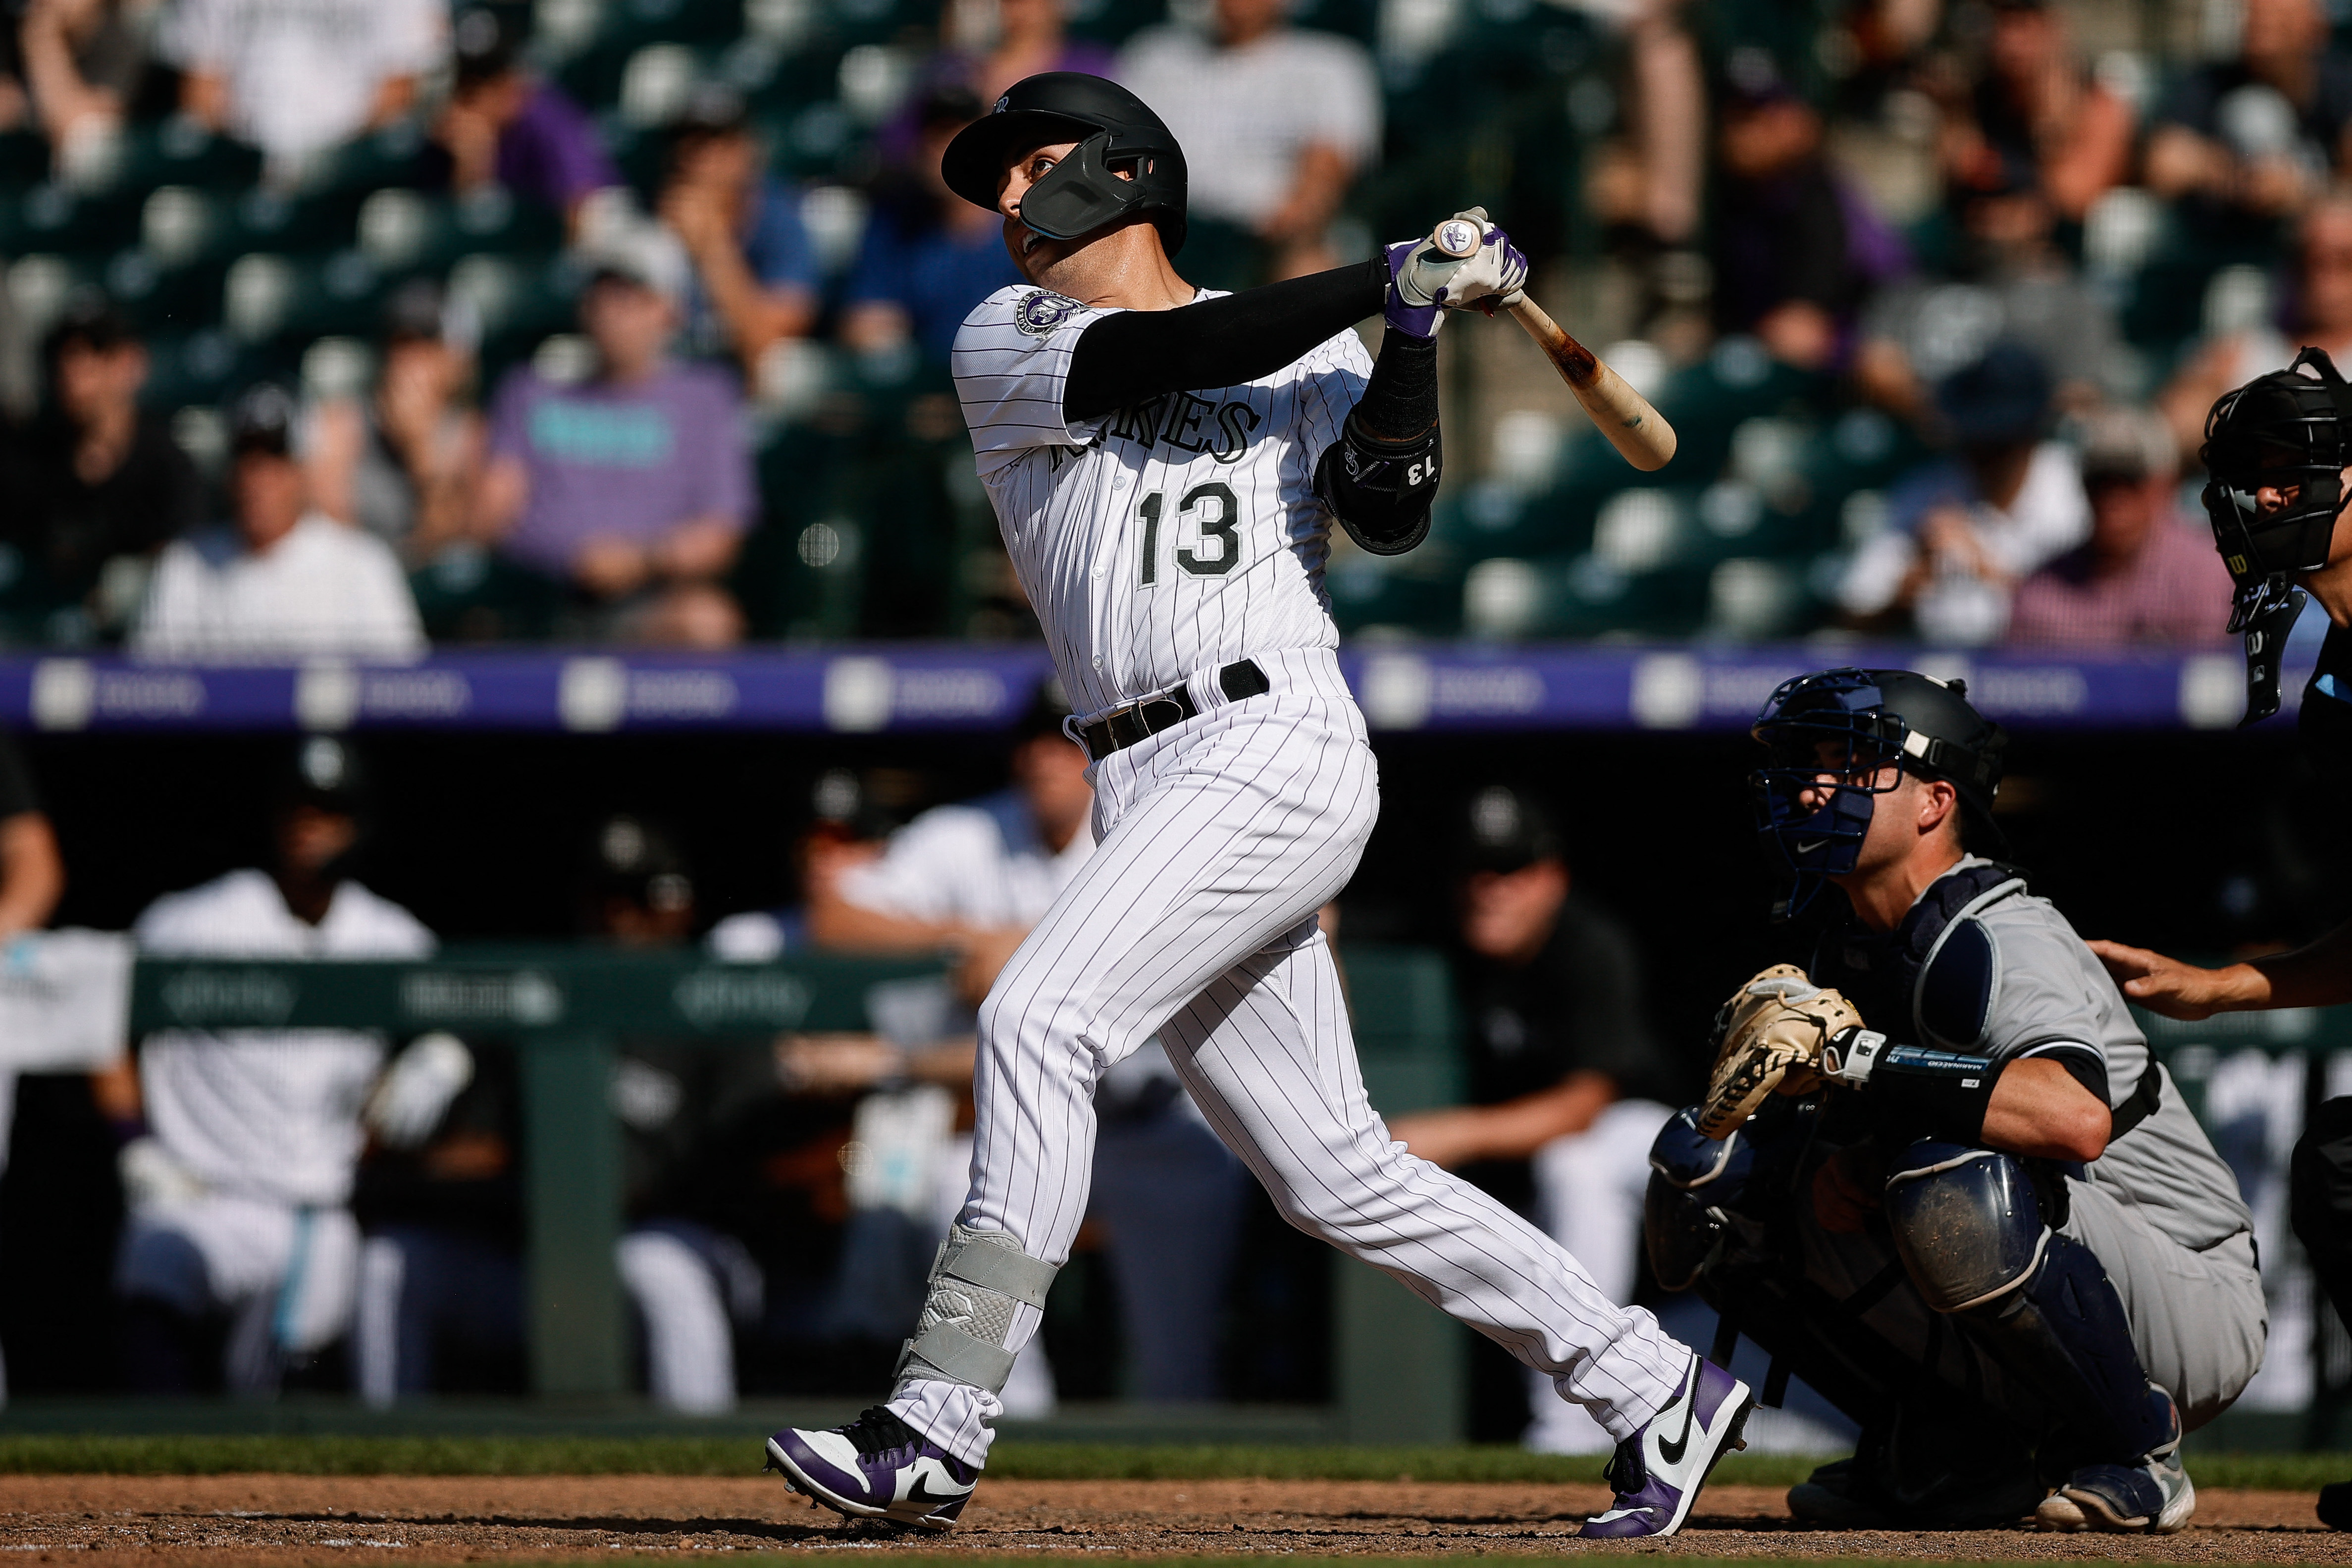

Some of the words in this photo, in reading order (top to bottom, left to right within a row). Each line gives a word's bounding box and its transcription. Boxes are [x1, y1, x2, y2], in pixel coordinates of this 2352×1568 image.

[1017, 296, 1035, 332] COLORADO
[1029, 297, 1073, 323] 30
[1408, 455, 1435, 486] 13
[1135, 478, 1244, 590] 13
[2228, 554, 2247, 574] W
